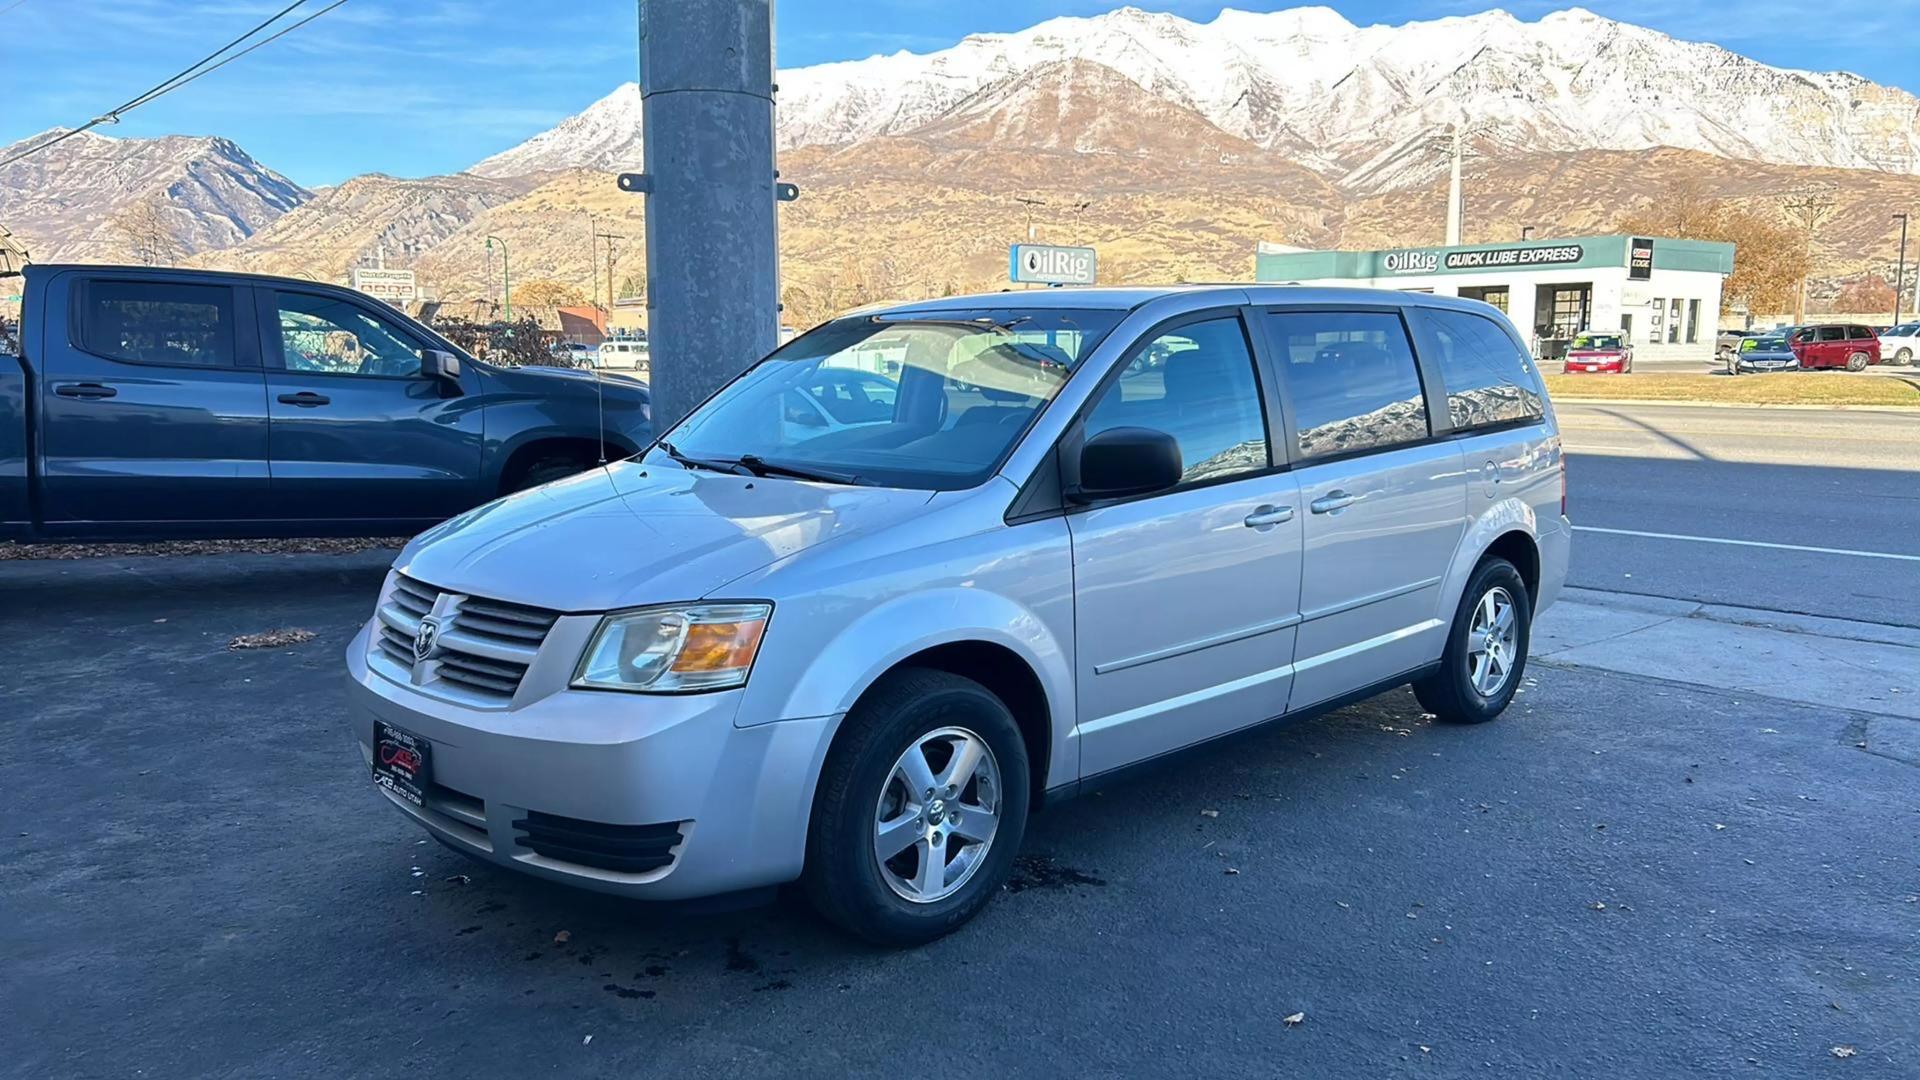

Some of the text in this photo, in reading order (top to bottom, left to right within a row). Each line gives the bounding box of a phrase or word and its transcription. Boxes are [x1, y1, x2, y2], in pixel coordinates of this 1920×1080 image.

[1024, 249, 1089, 280] OilRig
[1384, 247, 1580, 272] OilRig QUICK LUBE EXPRESS
[393, 784, 407, 797] AUTO
